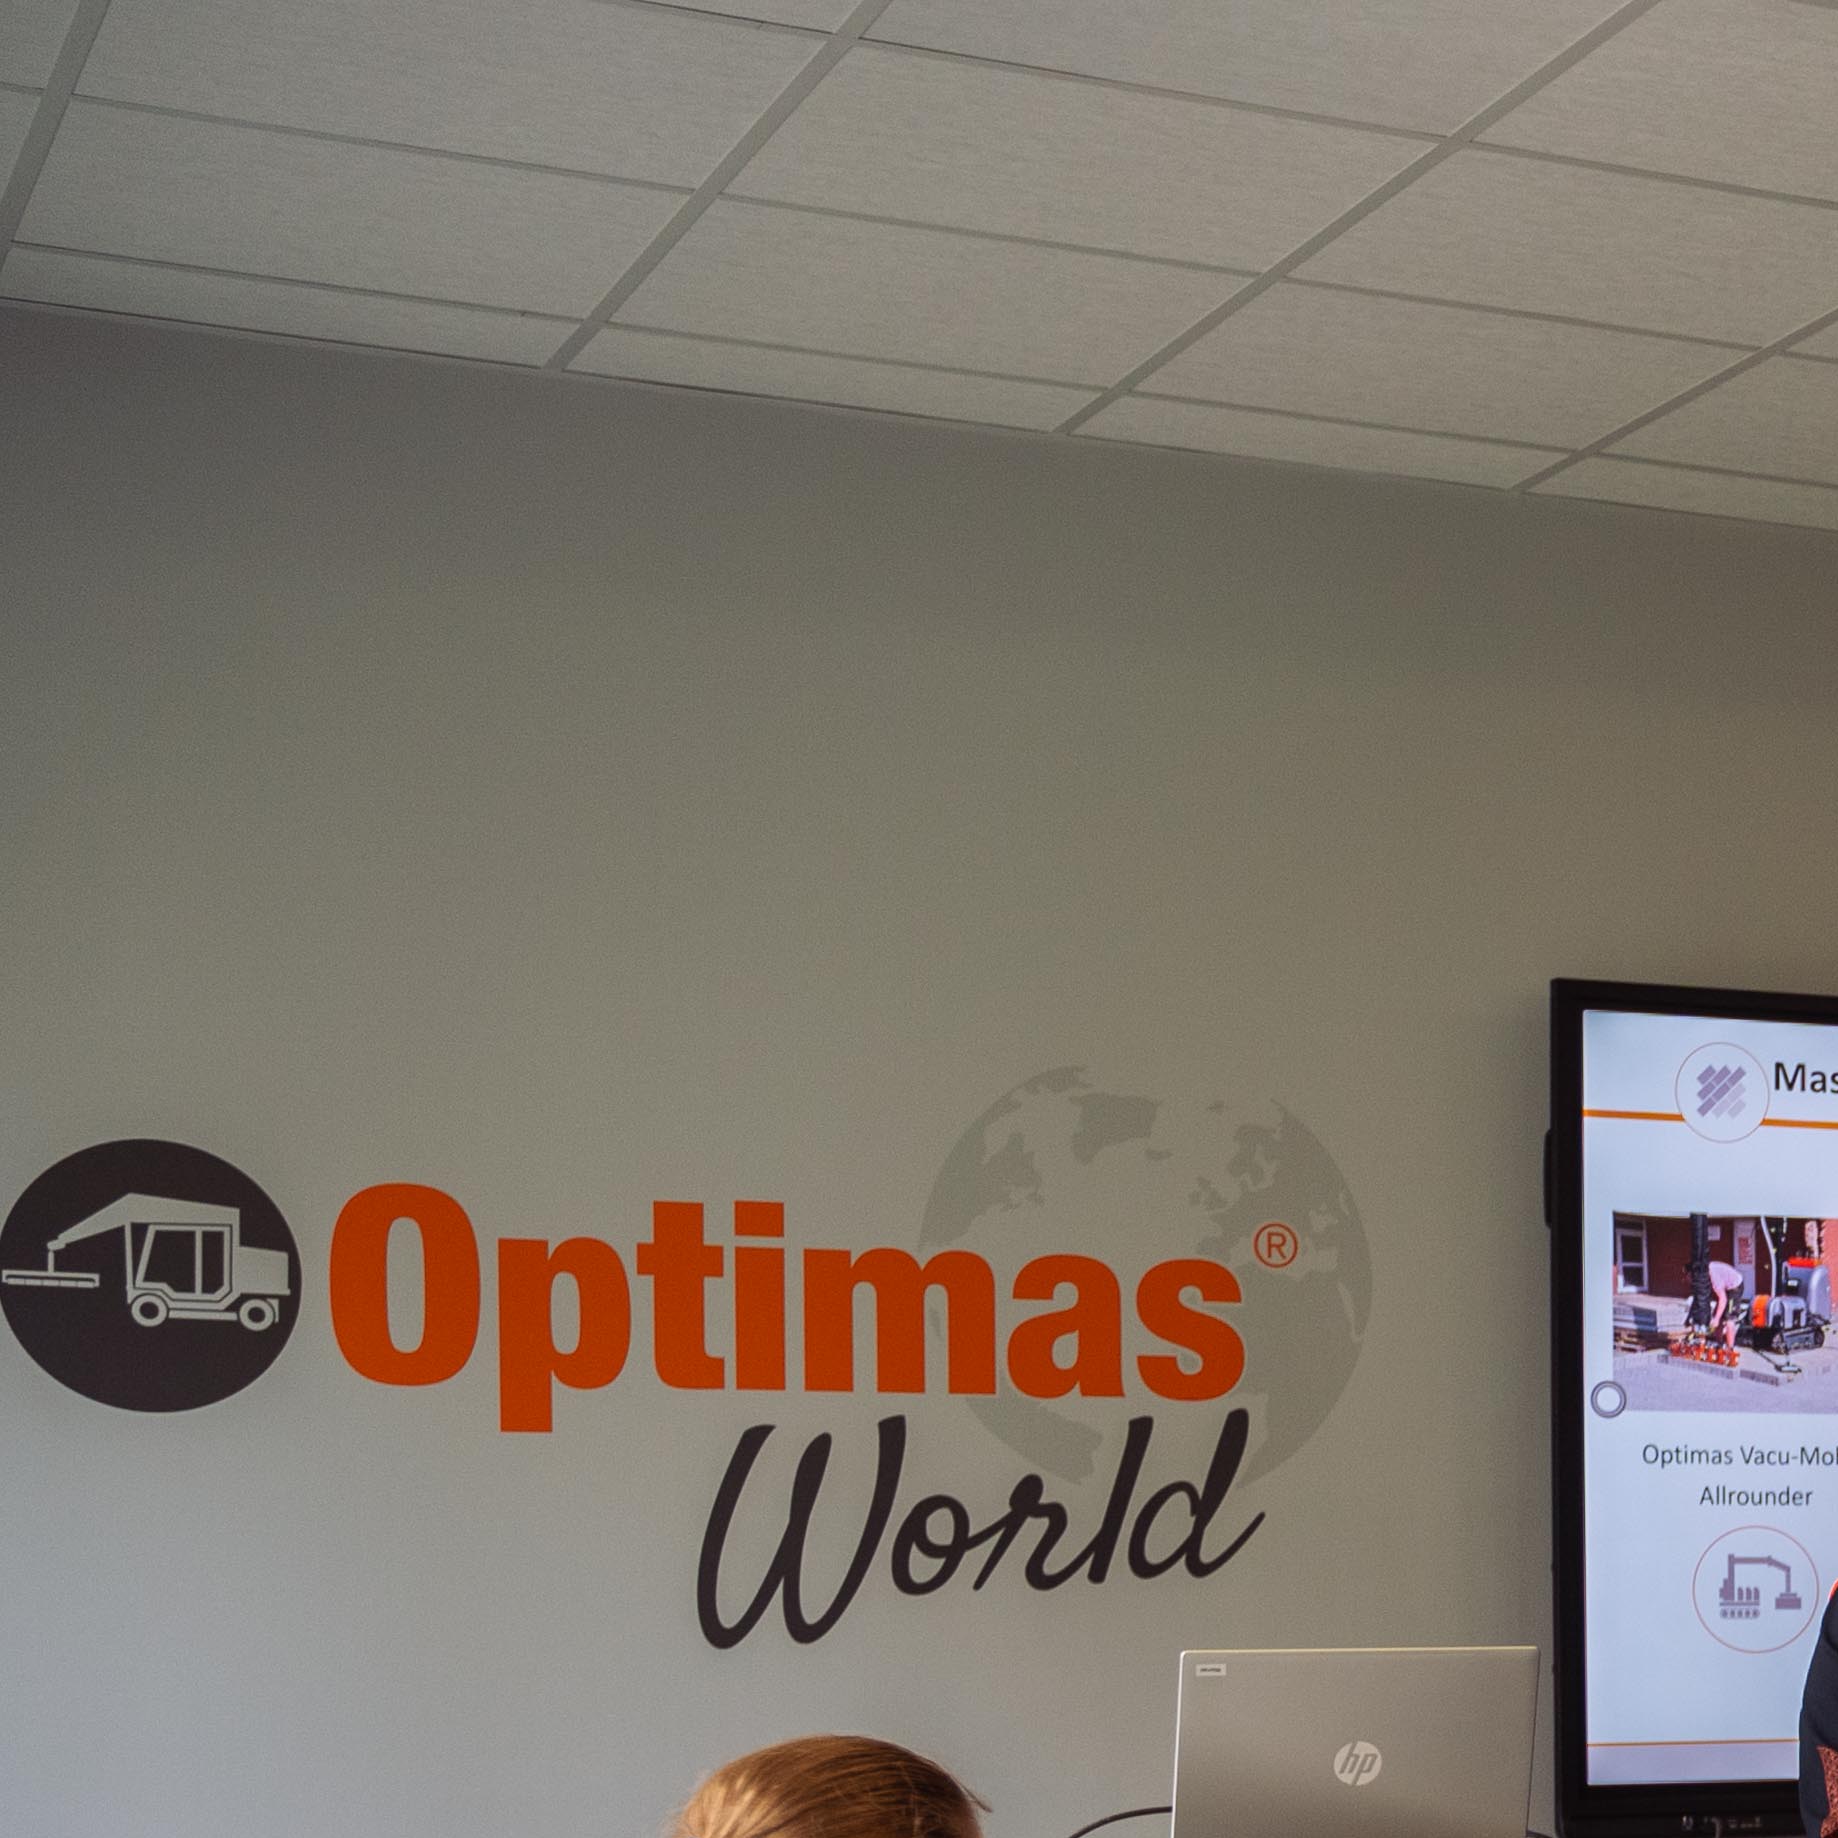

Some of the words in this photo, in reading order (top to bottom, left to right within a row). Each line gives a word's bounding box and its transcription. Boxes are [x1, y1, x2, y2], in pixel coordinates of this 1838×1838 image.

[1642, 1443, 1734, 1469] Optimas
[1699, 1485, 1814, 1507] Allrounder
[695, 1407, 1267, 1650] World
[1337, 1741, 1379, 1785] hp
